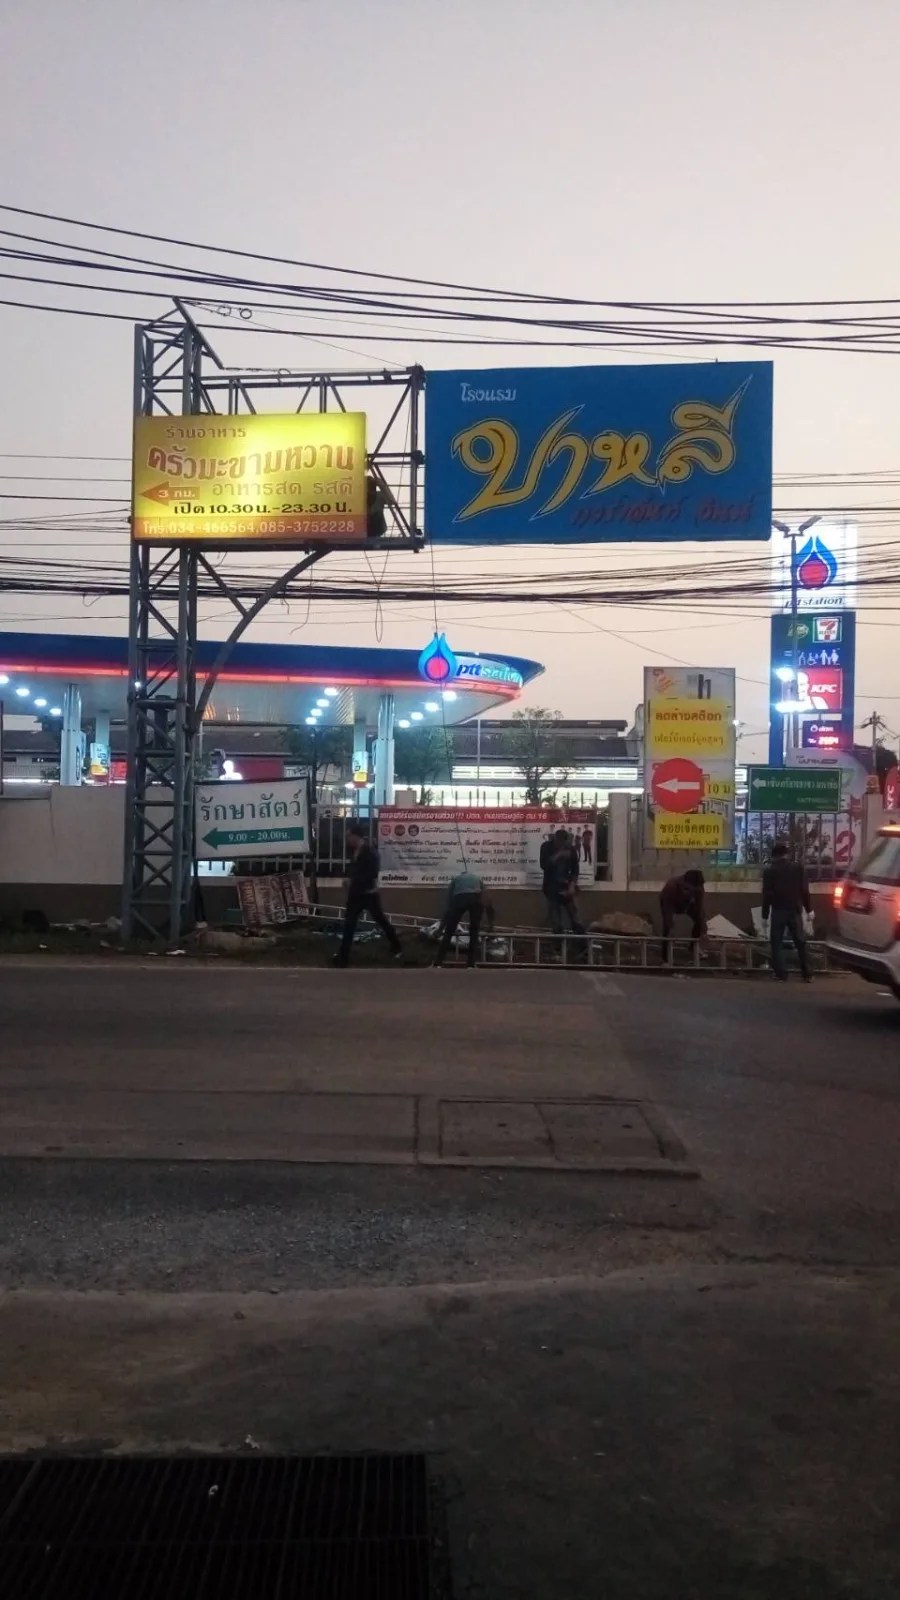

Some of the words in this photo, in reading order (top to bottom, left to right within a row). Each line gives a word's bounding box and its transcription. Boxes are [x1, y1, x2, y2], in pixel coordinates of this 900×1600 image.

[460, 382, 517, 402] โรงแรม
[166, 424, 247, 439] ร้านอาหาร
[146, 444, 354, 480] ครัวมะขามหวาน
[212, 480, 302, 496] อาหารสด
[312, 476, 353, 496] รสดี
[158, 490, 169, 498] 3
[173, 502, 205, 514] เปิด
[811, 684, 838, 693] KFC
[708, 784, 719, 794] 10
[200, 789, 302, 822] รักษาสัตว์
[228, 833, 248, 842] 9.00
